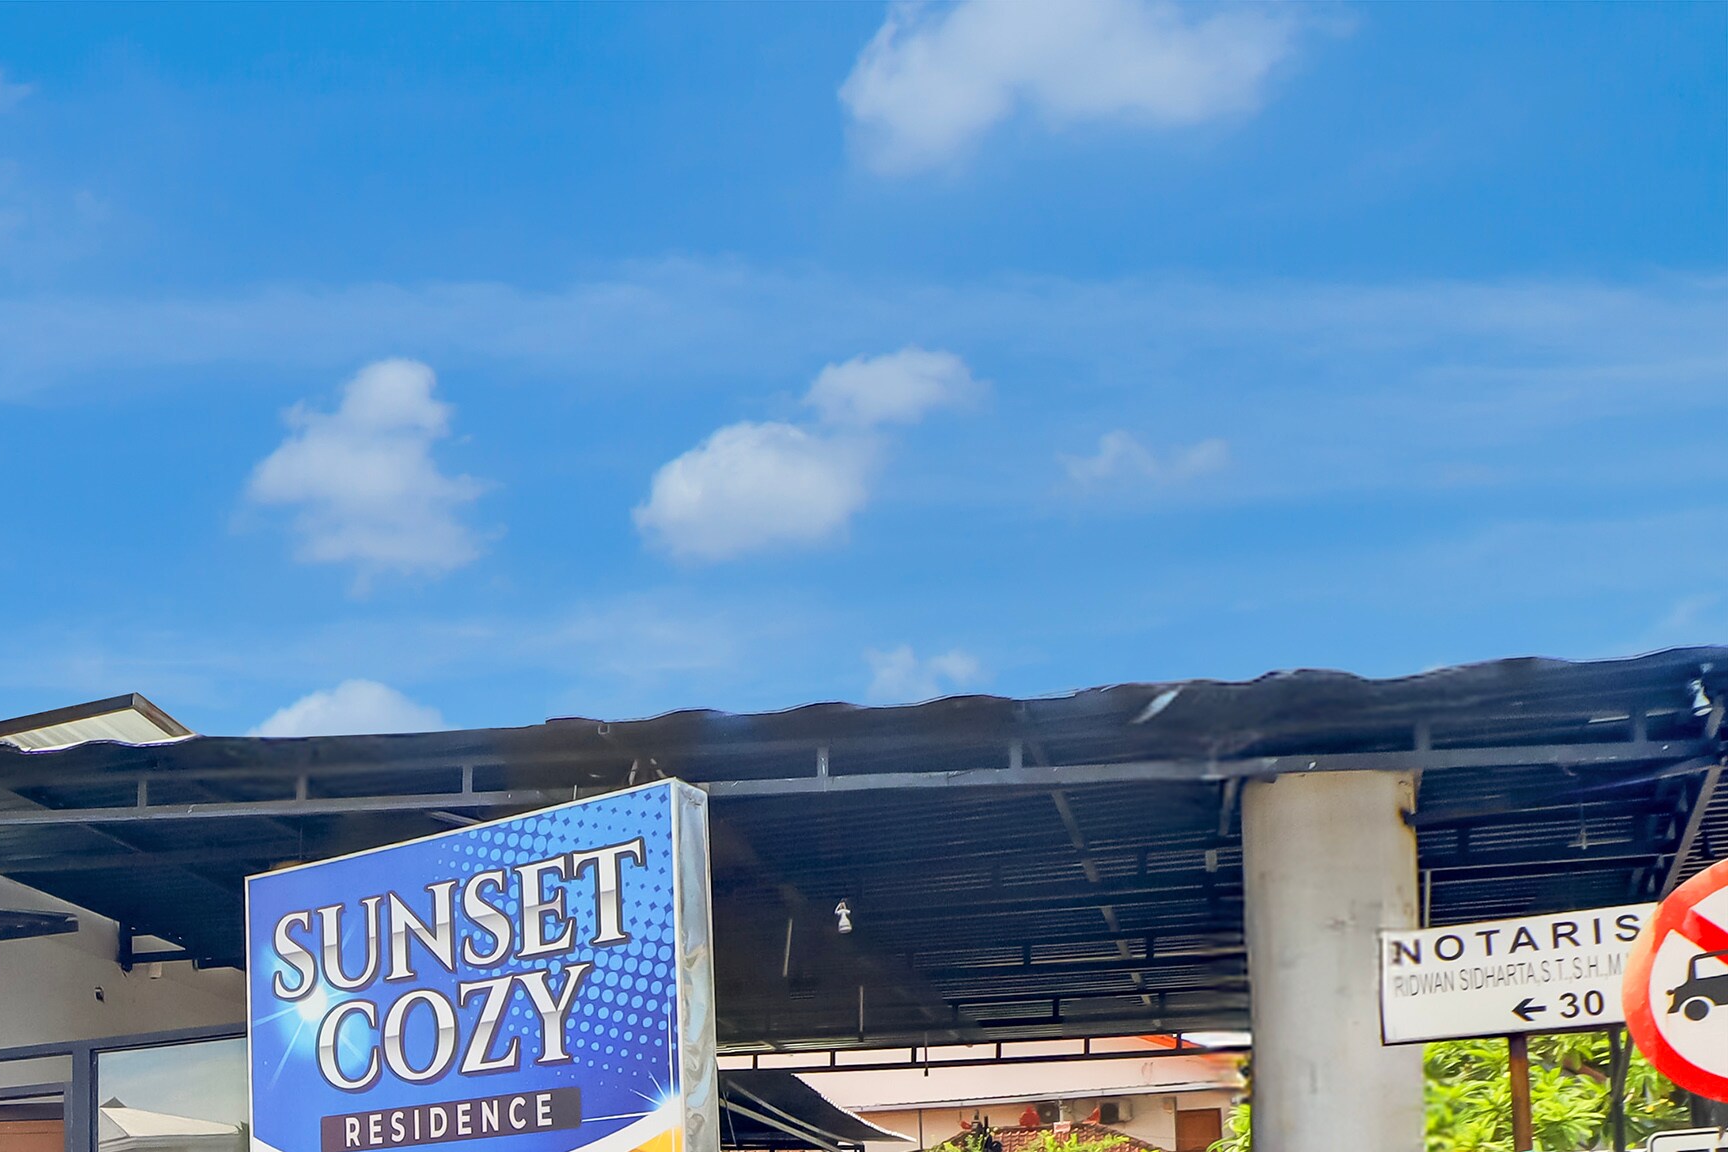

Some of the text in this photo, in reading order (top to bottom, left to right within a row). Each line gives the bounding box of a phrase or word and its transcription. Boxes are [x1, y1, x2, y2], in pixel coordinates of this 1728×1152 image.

[273, 837, 646, 1000] SUNSET
[1391, 914, 1641, 964] NOTARIS
[1393, 970, 1455, 998] RIDWAN
[1559, 989, 1605, 1019] 30
[316, 963, 591, 1092] COZY
[344, 1092, 554, 1148] RESIDENCE
